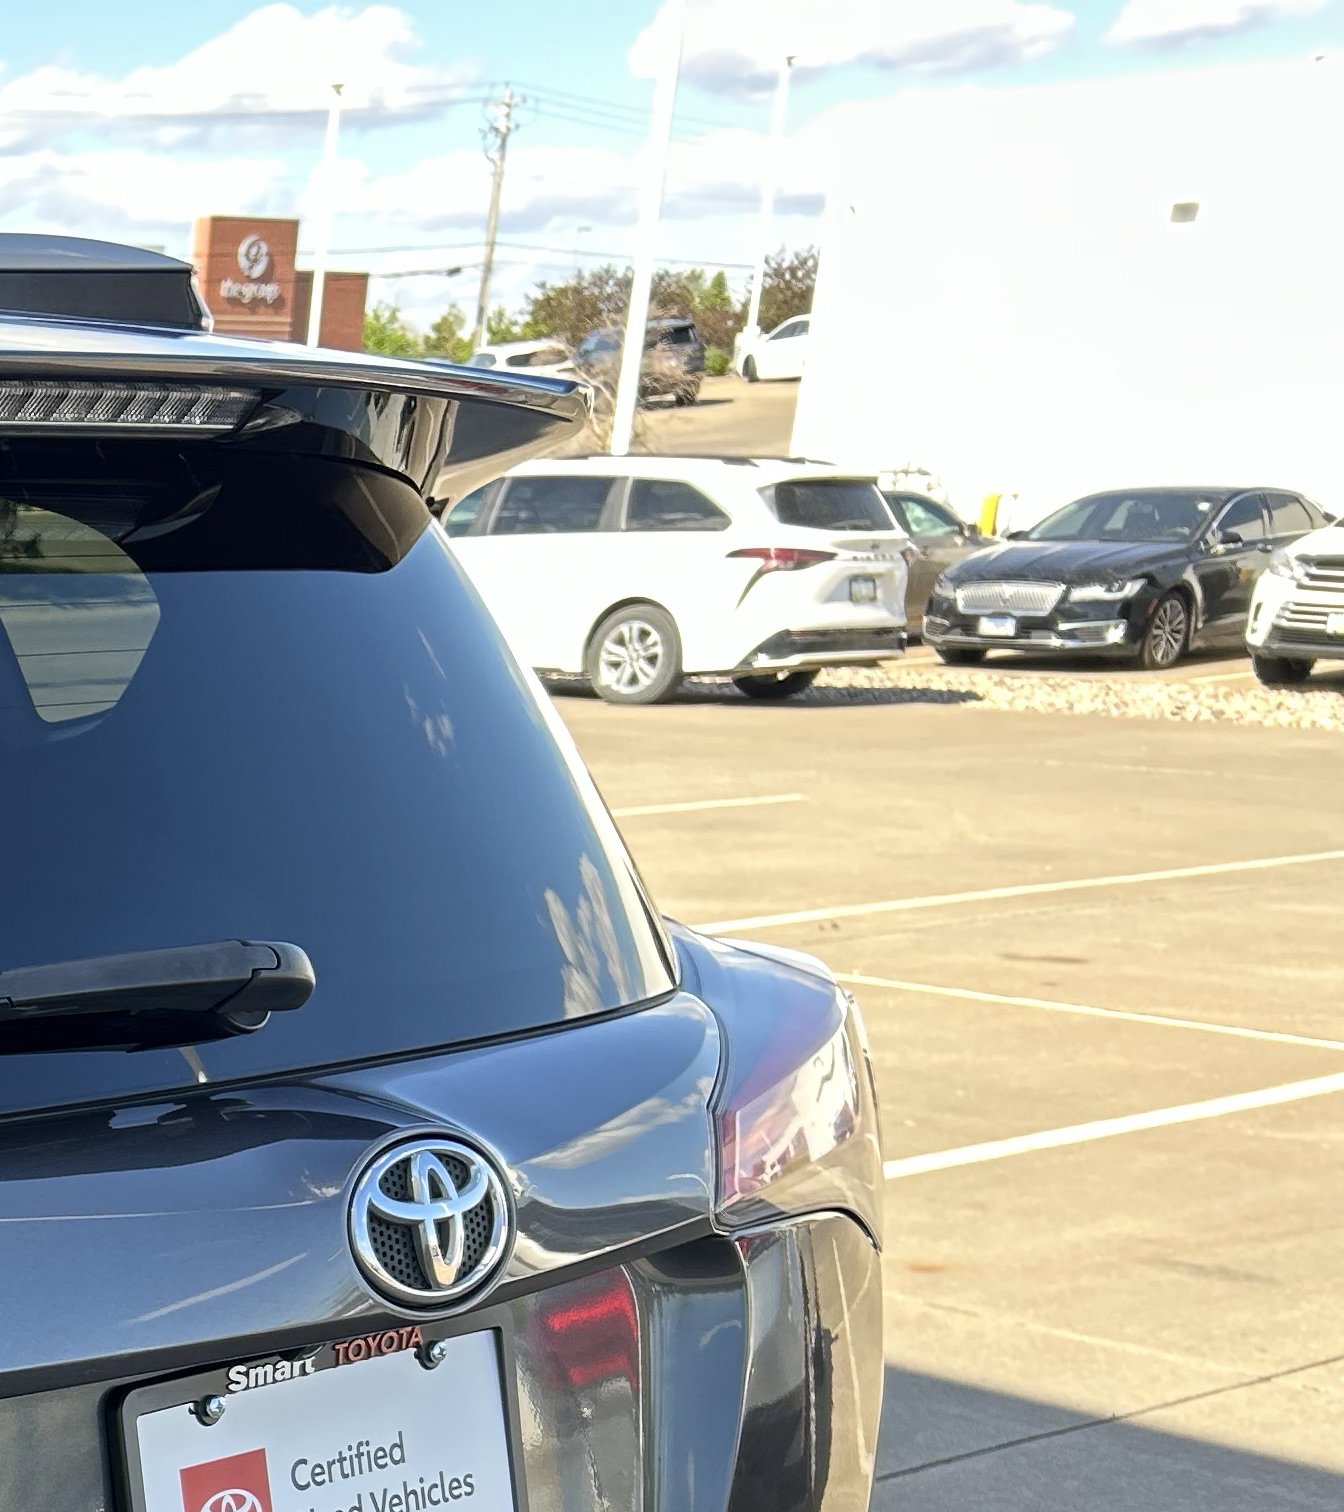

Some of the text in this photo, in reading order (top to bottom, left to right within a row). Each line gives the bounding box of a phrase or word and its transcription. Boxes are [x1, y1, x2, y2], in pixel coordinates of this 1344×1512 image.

[226, 1326, 425, 1392] Smart TOYOTA
[290, 1430, 406, 1491] Certified
